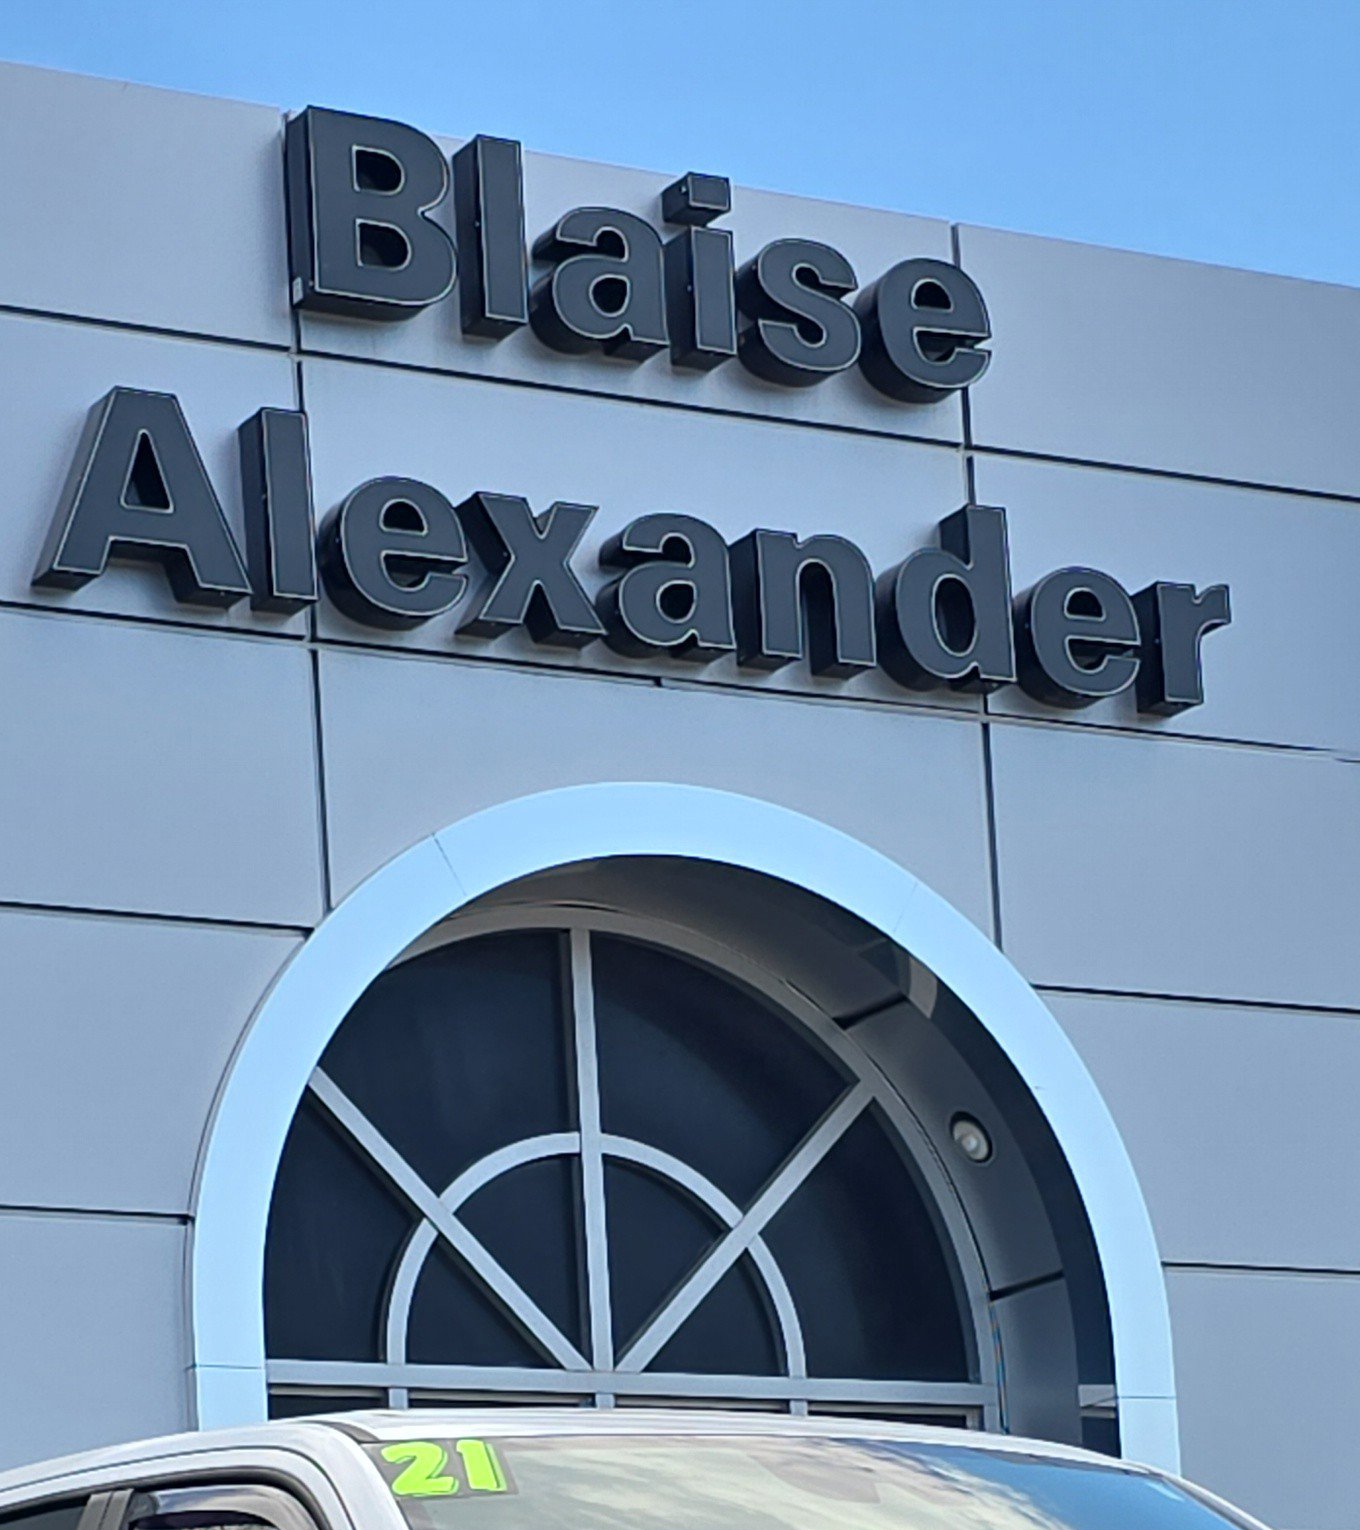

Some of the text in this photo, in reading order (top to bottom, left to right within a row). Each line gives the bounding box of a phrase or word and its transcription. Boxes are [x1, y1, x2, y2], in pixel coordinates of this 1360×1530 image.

[286, 104, 992, 402] Blaise
[31, 385, 1231, 717] Alexander
[380, 1438, 507, 1497] 21
